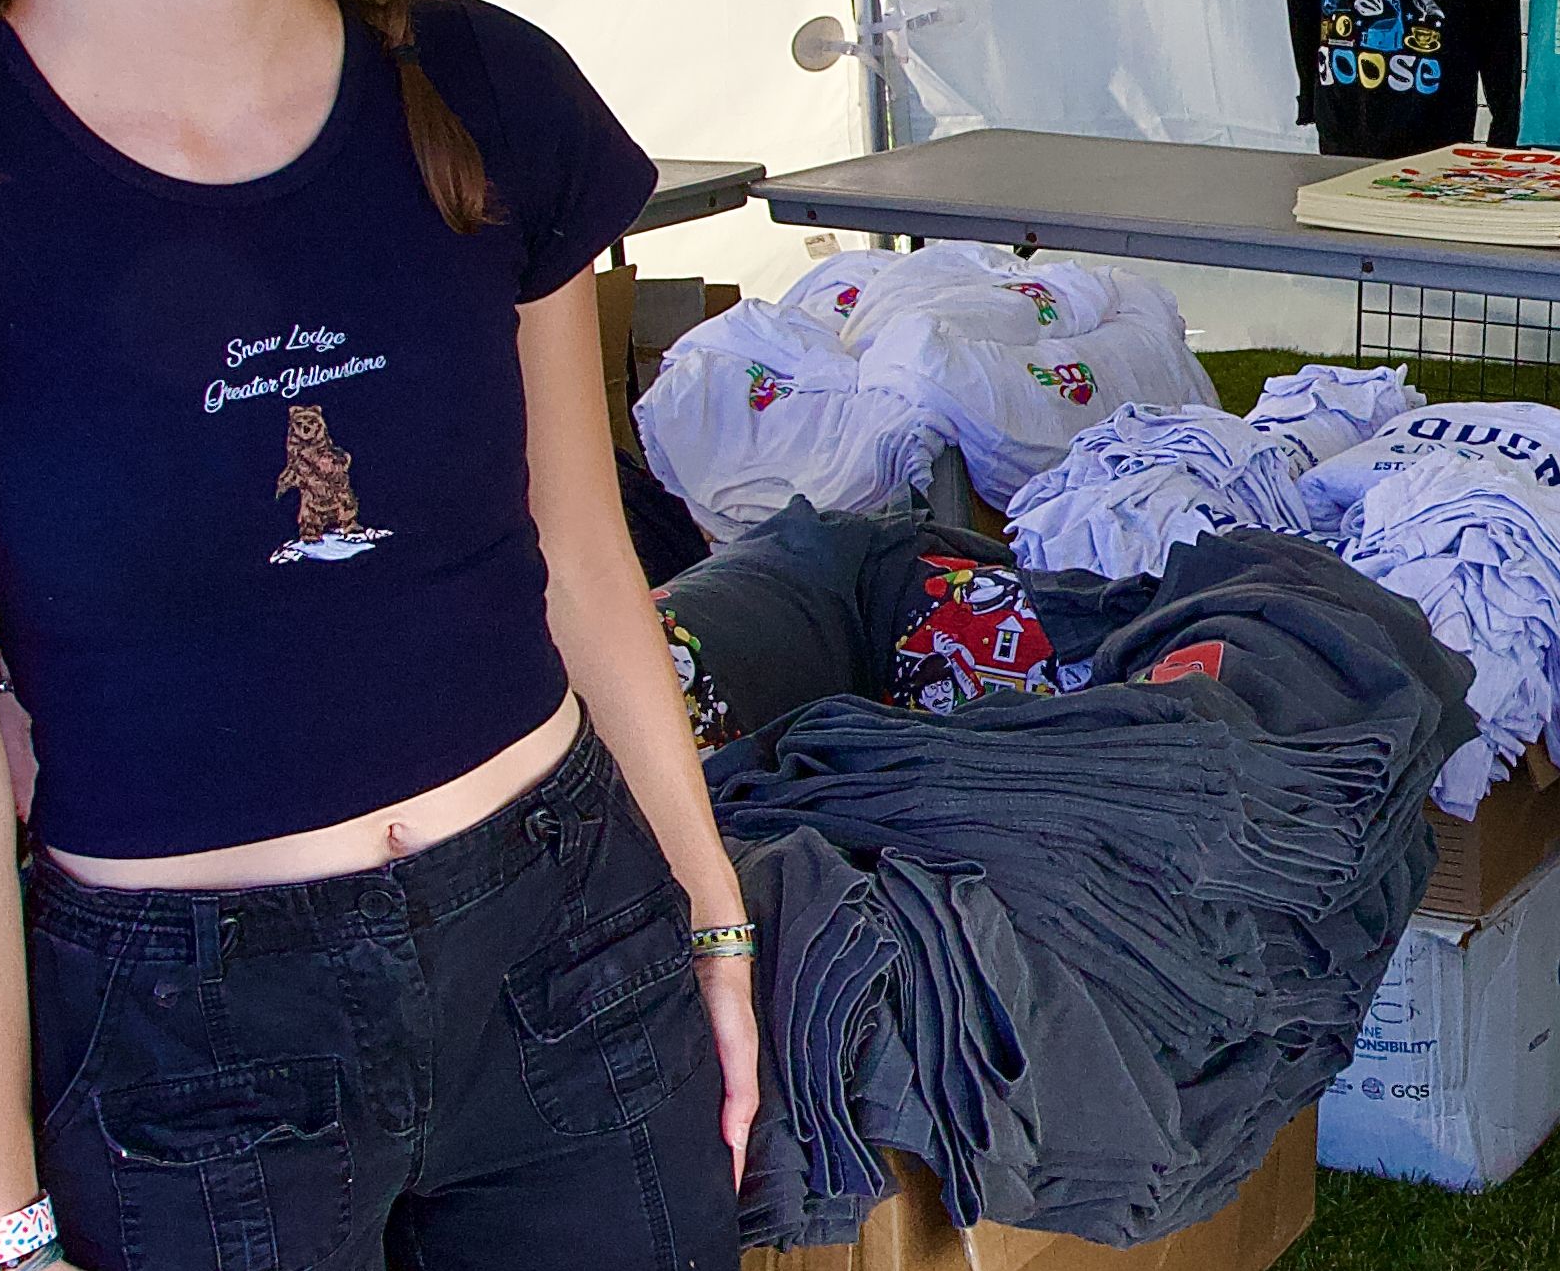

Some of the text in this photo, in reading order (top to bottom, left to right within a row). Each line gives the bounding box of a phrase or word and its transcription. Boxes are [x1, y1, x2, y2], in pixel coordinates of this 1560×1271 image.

[227, 324, 346, 368] Snow Lodge
[204, 351, 387, 413] Greater Yellowstone
